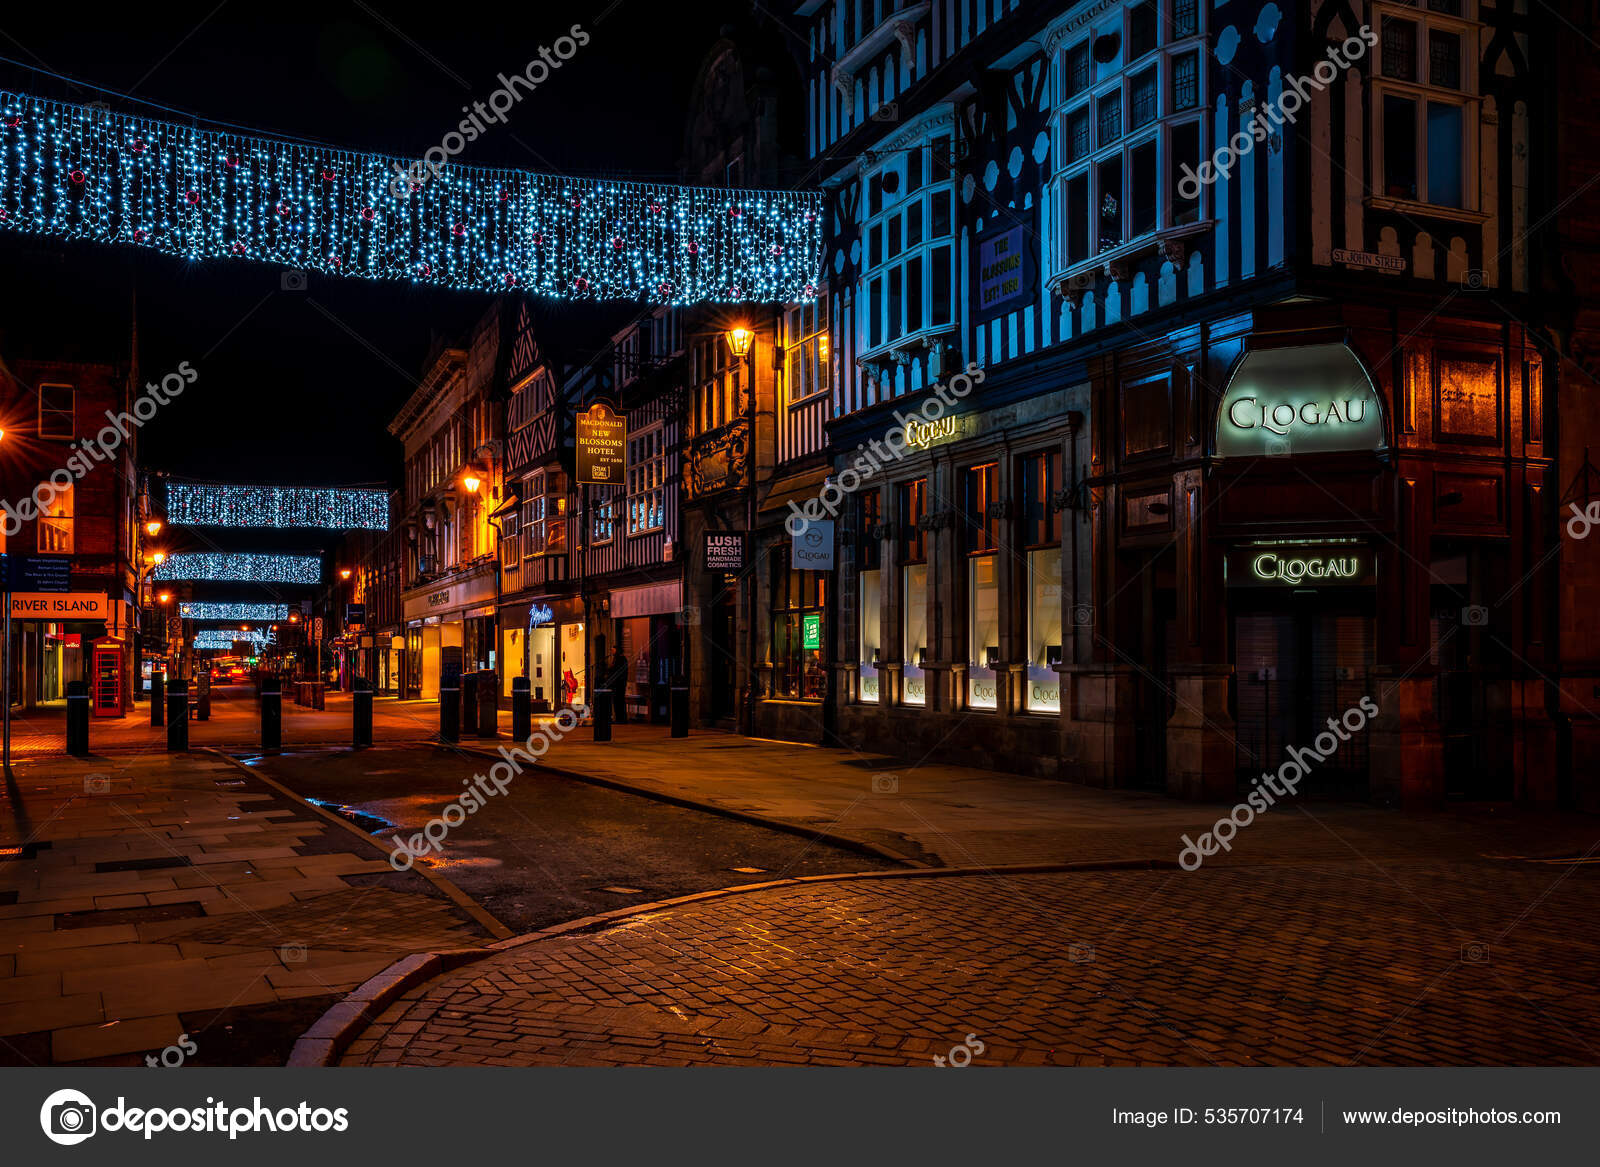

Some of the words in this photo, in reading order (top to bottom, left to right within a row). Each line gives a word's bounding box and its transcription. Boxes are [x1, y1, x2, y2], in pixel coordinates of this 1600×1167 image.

[1347, 252, 1372, 265] JOHN
[1374, 255, 1403, 269] STREET
[579, 438, 623, 447] BLOSSOMS
[587, 447, 615, 455] HOTEL
[707, 535, 742, 546] LUSH
[707, 546, 742, 556] FRESH
[12, 600, 48, 611] RIVER
[53, 600, 98, 611] ISLAND
